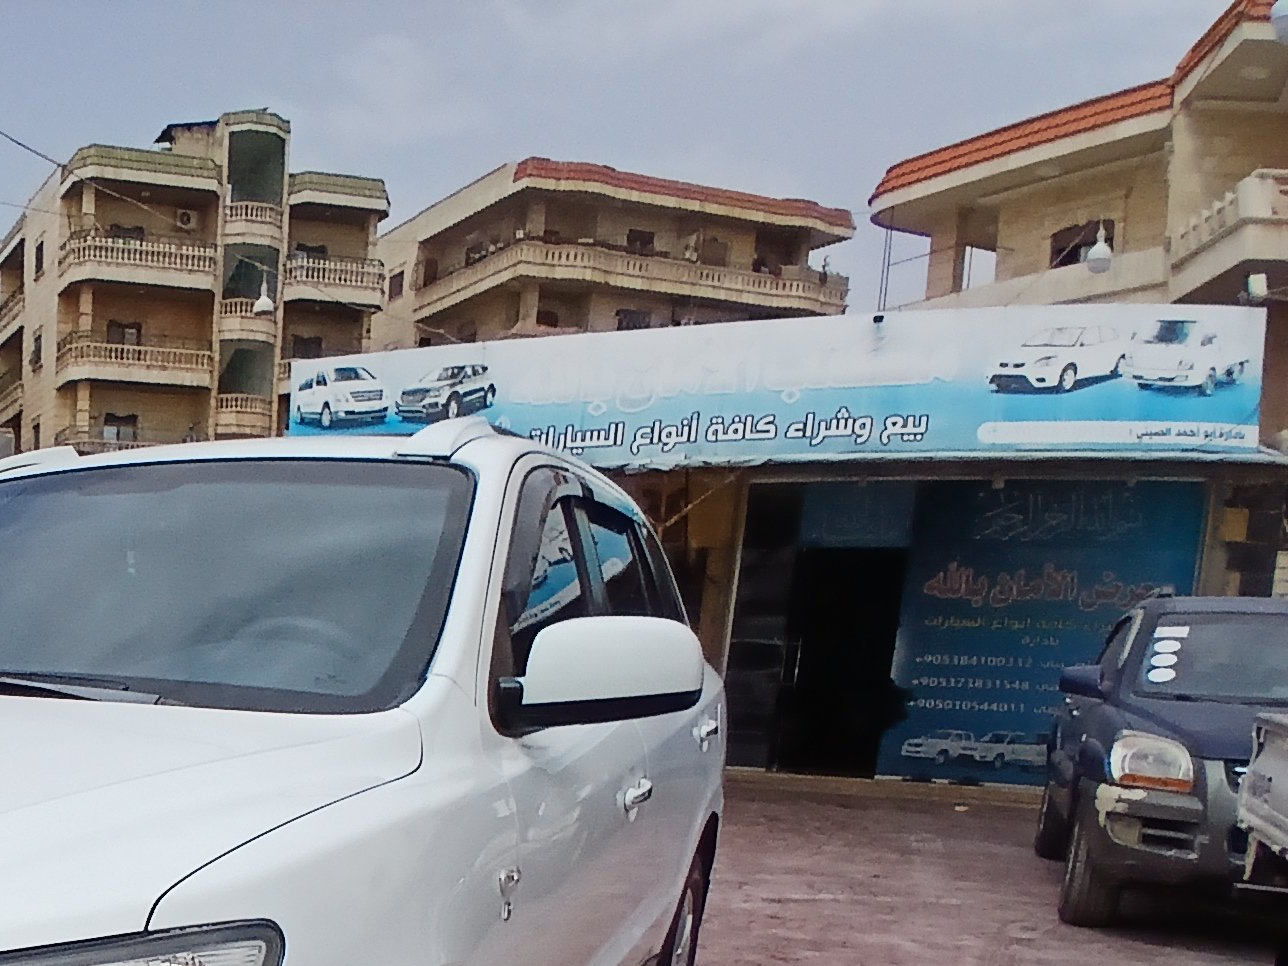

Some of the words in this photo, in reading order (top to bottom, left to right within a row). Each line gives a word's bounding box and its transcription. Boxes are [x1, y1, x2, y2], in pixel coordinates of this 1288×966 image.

[630, 410, 701, 456] أنواع
[705, 412, 777, 444] كافة
[785, 406, 873, 447] وشراء
[879, 413, 929, 447] بيع
